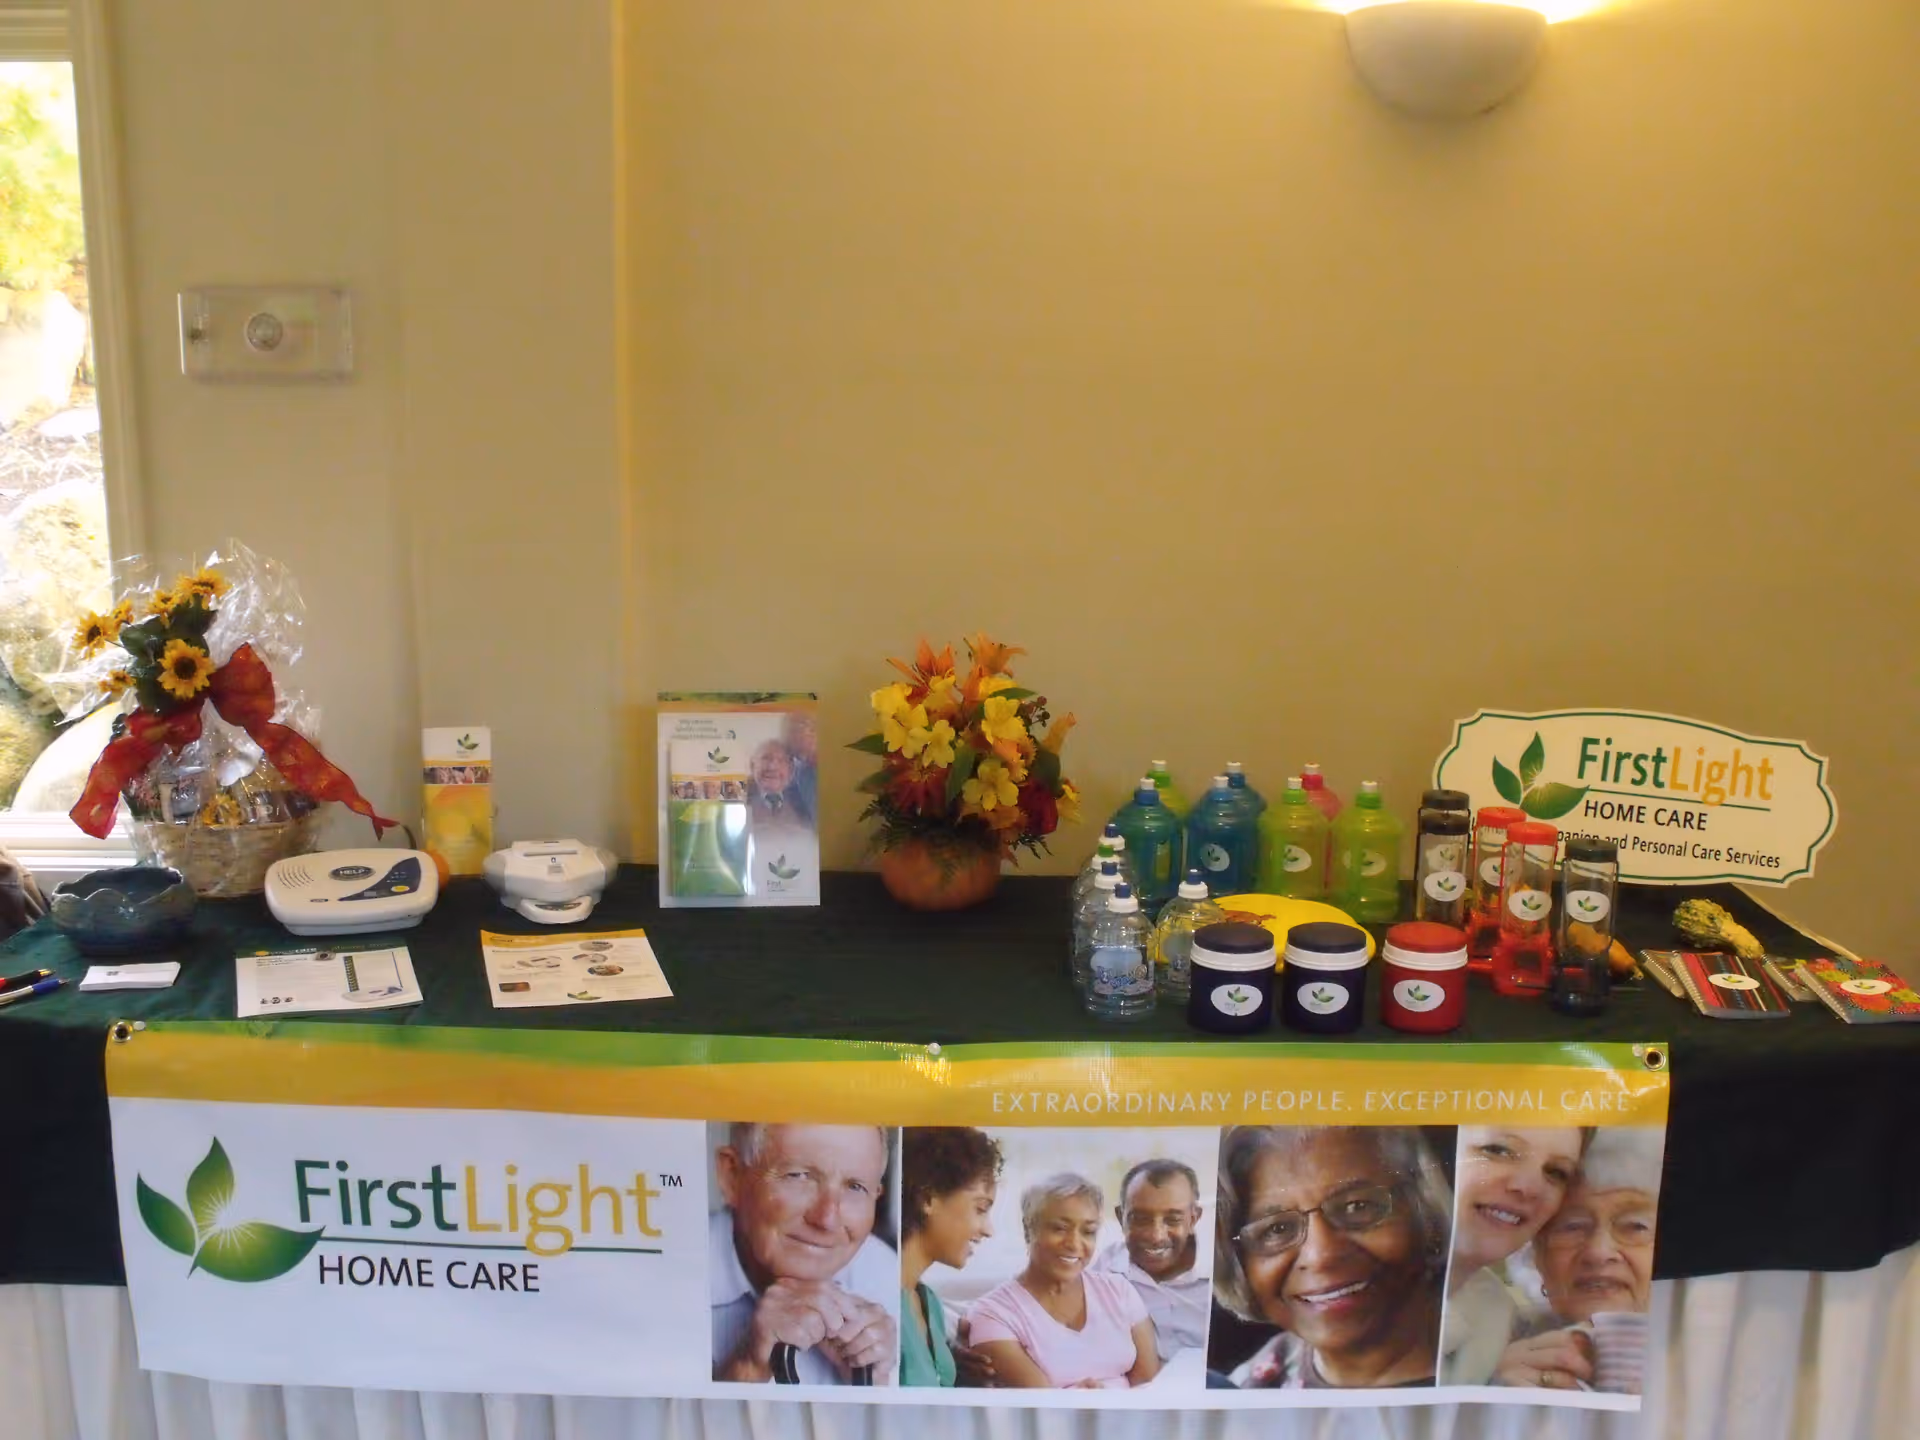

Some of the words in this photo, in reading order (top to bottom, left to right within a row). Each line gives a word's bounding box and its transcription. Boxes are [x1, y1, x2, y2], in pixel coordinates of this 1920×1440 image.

[1577, 737, 1774, 807] FirstLight
[1584, 799, 1647, 824] HOME
[1654, 807, 1709, 831] CARE
[1631, 836, 1688, 857] Personal
[1691, 843, 1722, 861] Care
[1725, 847, 1781, 869] Services
[339, 867, 366, 876] HELP
[992, 1091, 1232, 1113] EXTRAORDINARY
[1243, 1090, 1352, 1111] PEOPLE.
[1364, 1089, 1549, 1111] EXCEPTIONAL
[294, 1159, 663, 1258] FirstLight
[318, 1255, 435, 1289] HOME
[446, 1260, 540, 1293] CARE
